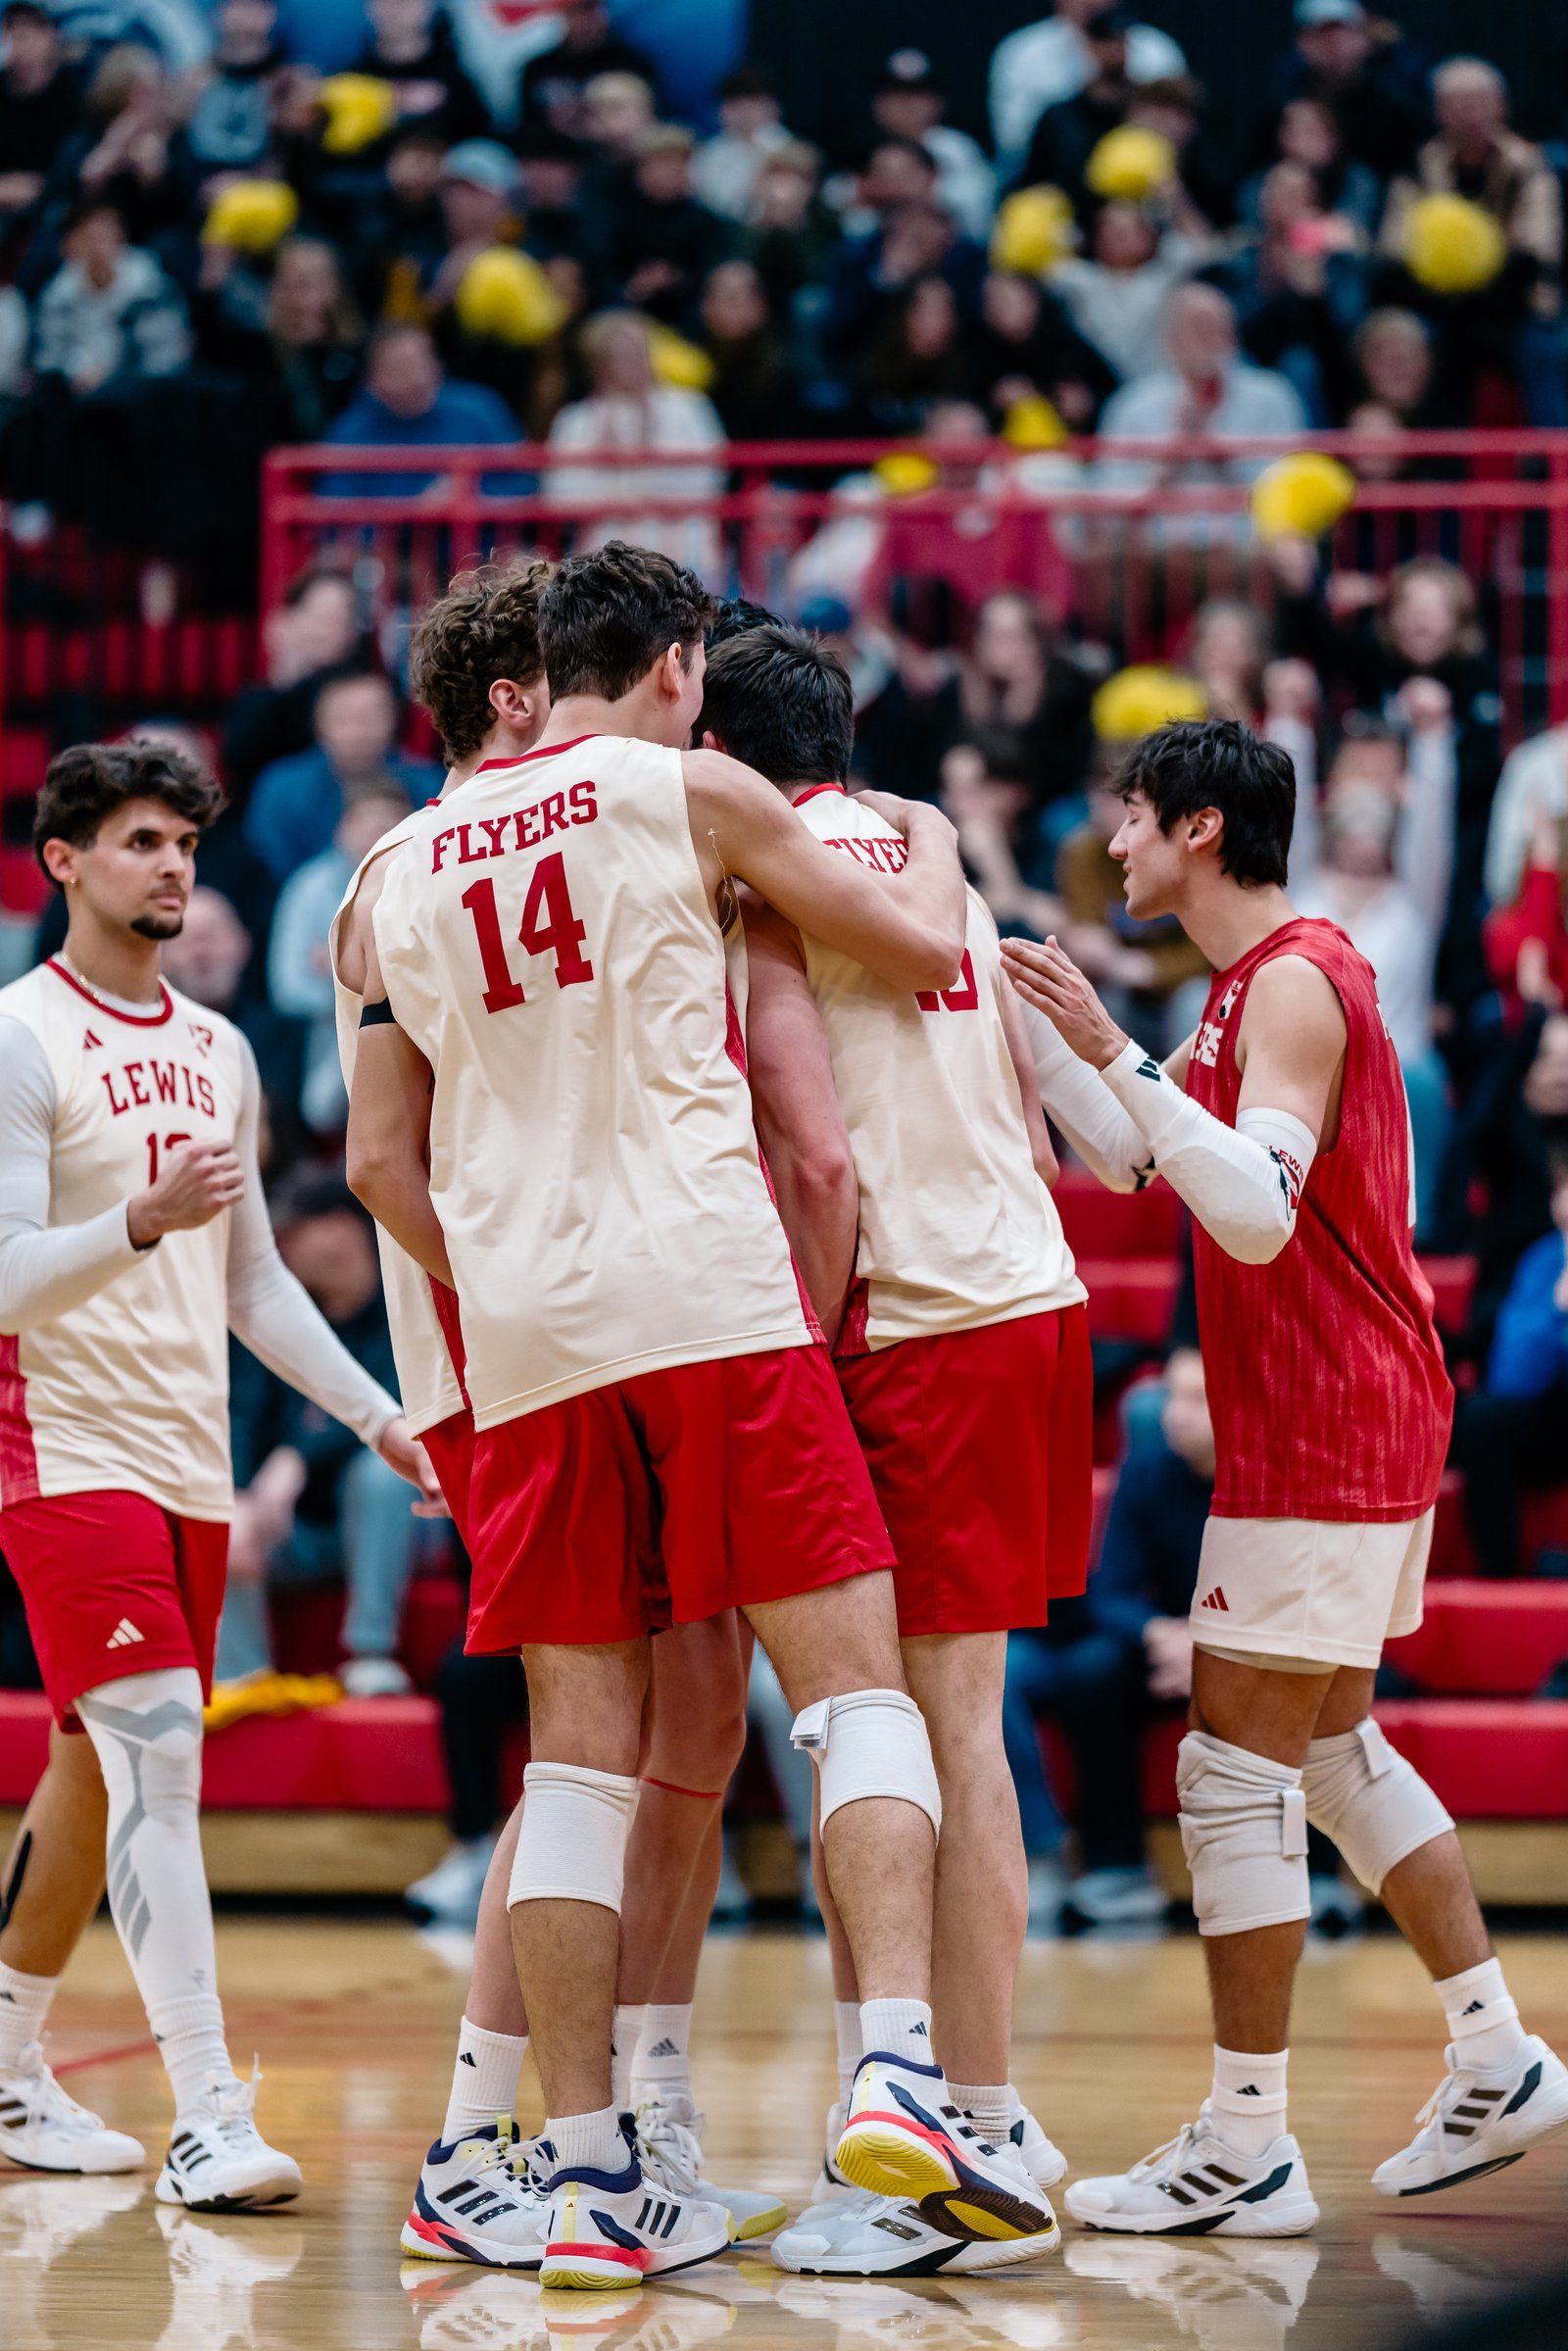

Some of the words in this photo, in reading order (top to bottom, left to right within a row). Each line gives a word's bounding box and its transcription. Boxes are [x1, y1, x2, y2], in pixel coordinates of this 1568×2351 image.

[432, 780, 598, 874] FLYERS
[462, 851, 594, 1014] 14
[101, 1059, 216, 1117] LEWIS
[146, 1132, 192, 1186] 1
